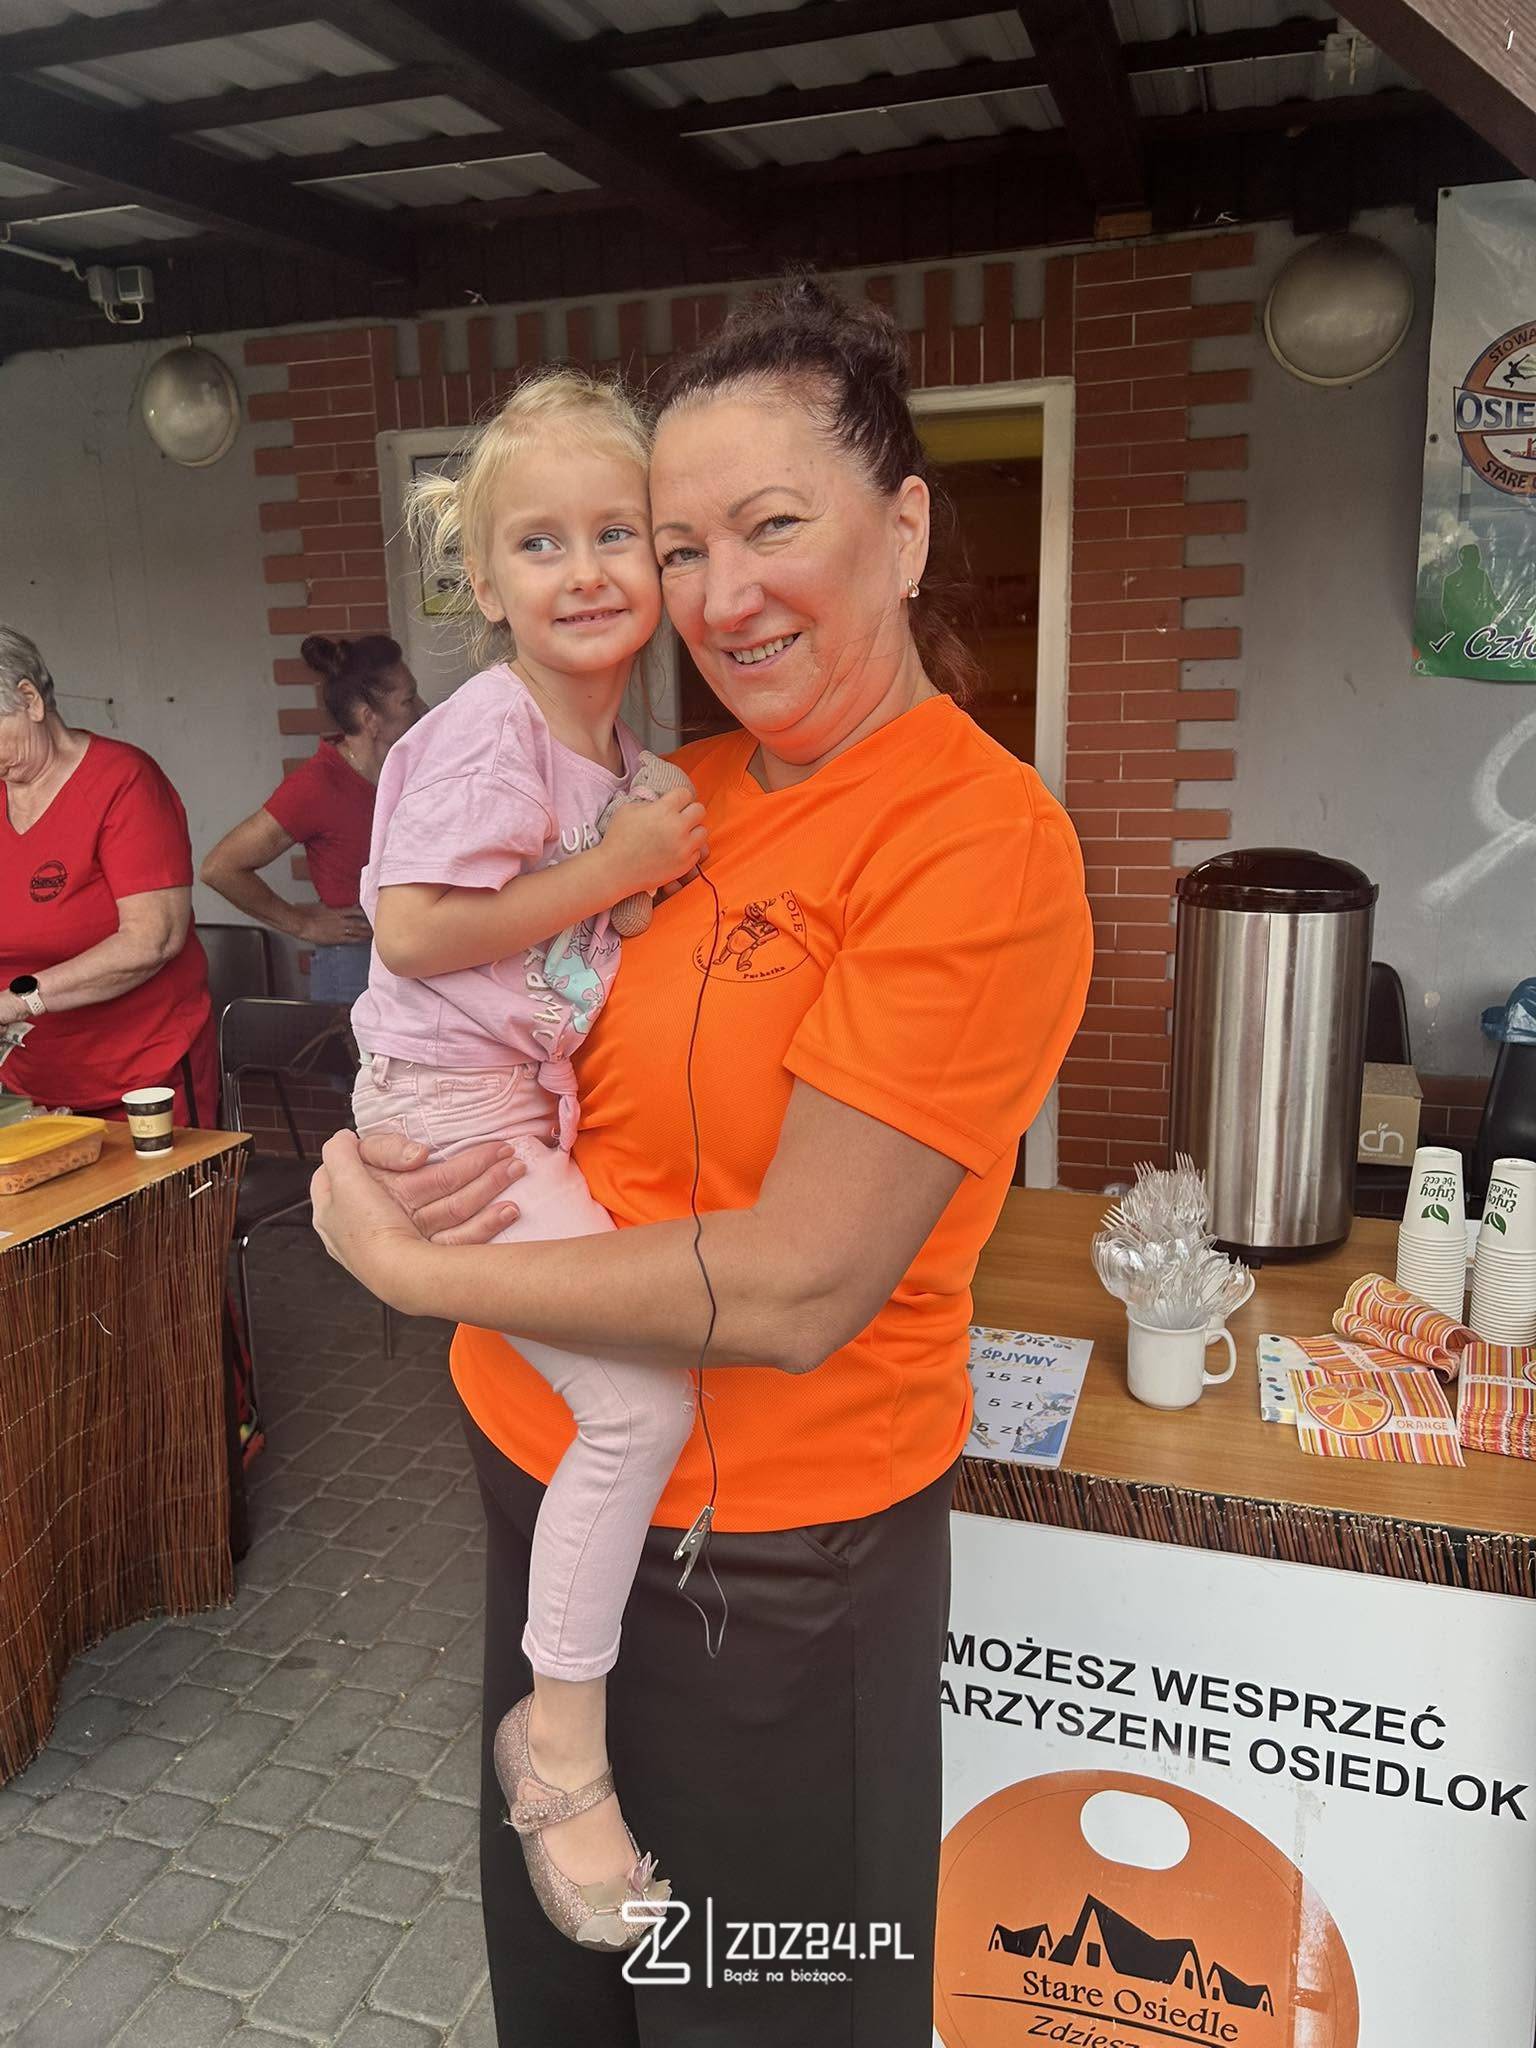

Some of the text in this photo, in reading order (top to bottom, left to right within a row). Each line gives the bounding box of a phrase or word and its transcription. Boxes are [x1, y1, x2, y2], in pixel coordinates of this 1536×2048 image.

[1482, 460, 1529, 488] STARE
[1420, 1183, 1456, 1202] Enjoy
[985, 1371, 1011, 1381] 15
[987, 1398, 1001, 1407] 5
[1396, 1419, 1448, 1430] ORANGE
[943, 1631, 1447, 1751] MOŻESZ WESPRZEĆ
[1248, 1738, 1530, 1822] OSIEDLOK
[1023, 1970, 1239, 2042] Stare Osiedle
